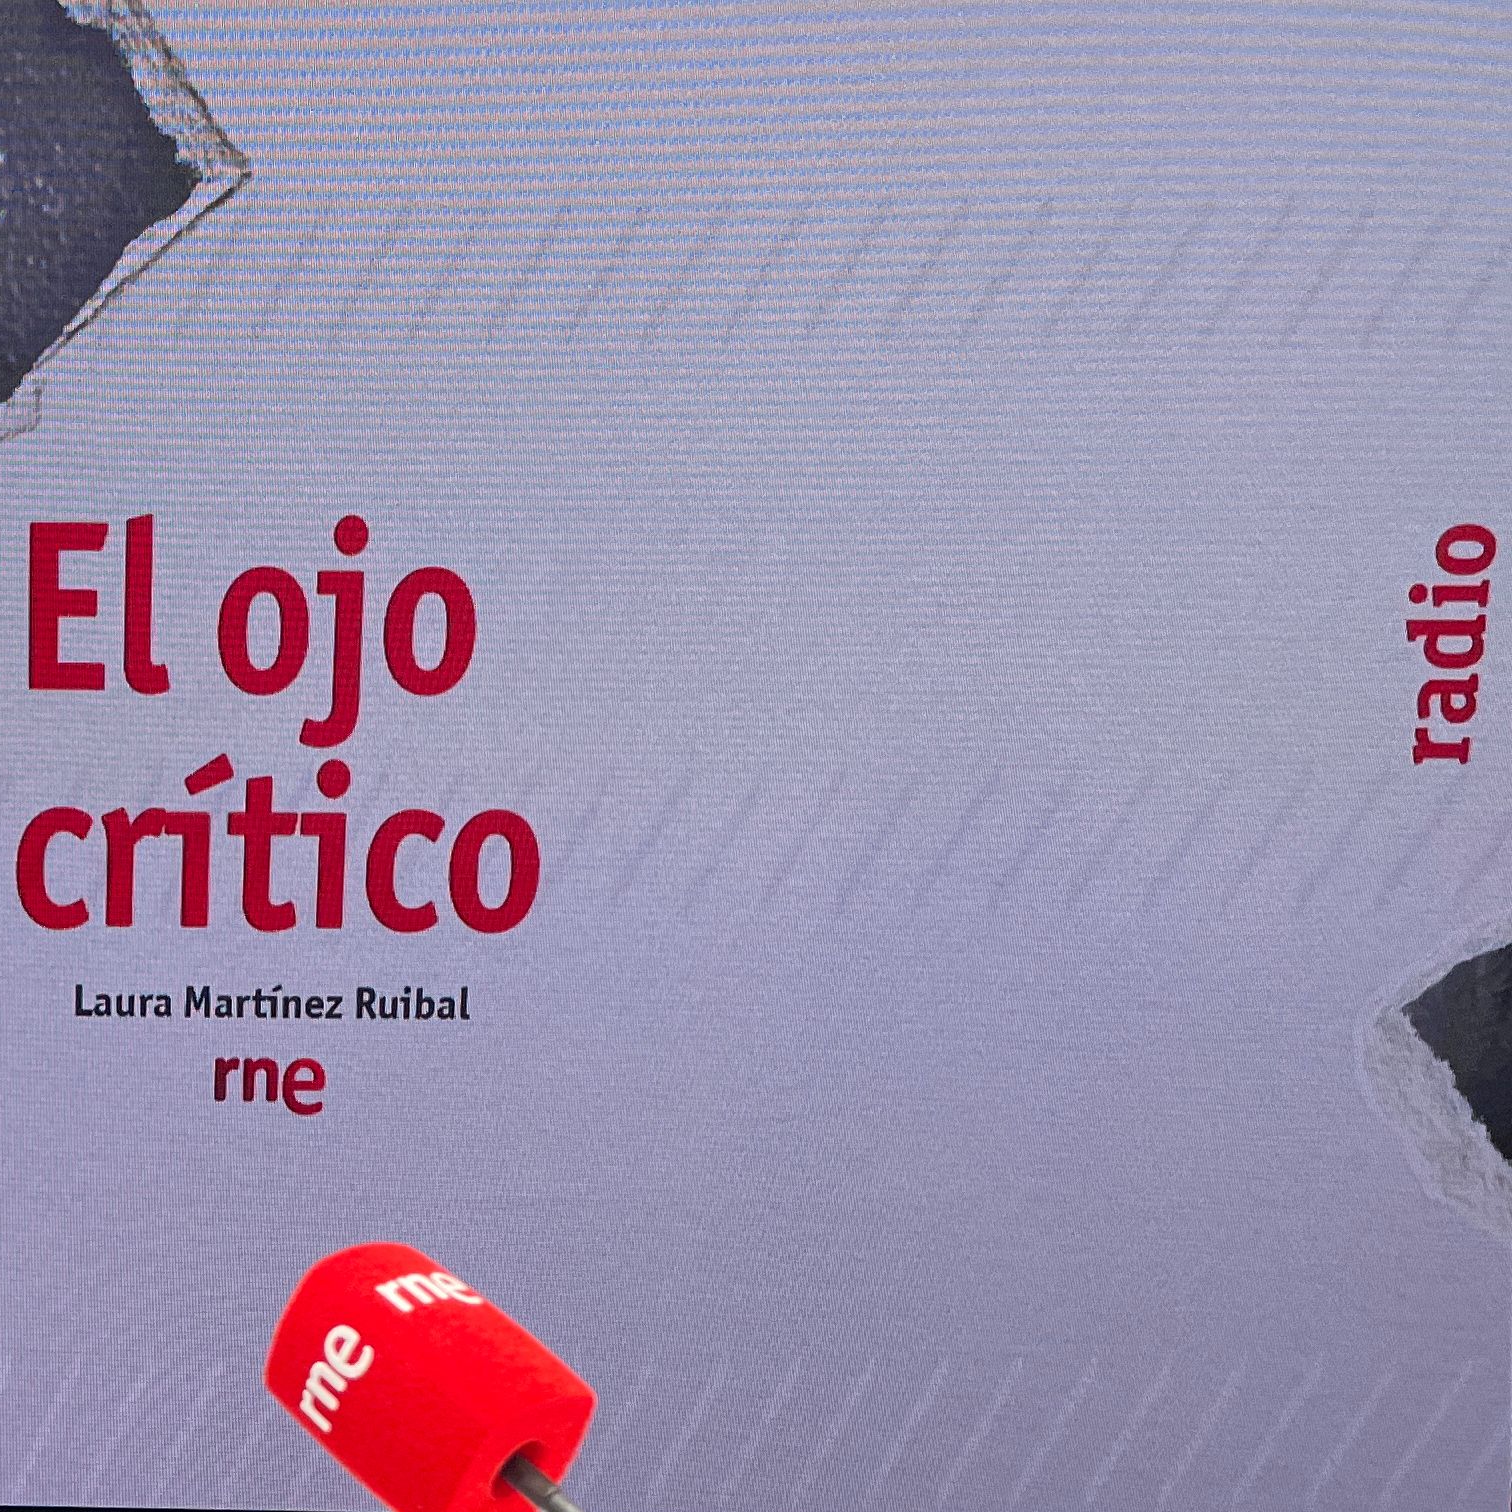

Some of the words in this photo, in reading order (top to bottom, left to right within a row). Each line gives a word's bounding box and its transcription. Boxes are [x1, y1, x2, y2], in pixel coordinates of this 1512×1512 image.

[29, 514, 171, 696] El
[217, 514, 478, 748] ojo
[1406, 523, 1498, 764] radio
[16, 753, 541, 934] crítico
[74, 984, 173, 1018] Laura
[184, 984, 343, 1019] Martínez
[355, 985, 470, 1020] Ruibal
[213, 1056, 327, 1116] rne
[375, 1271, 484, 1313] rne
[298, 1323, 376, 1434] rne
